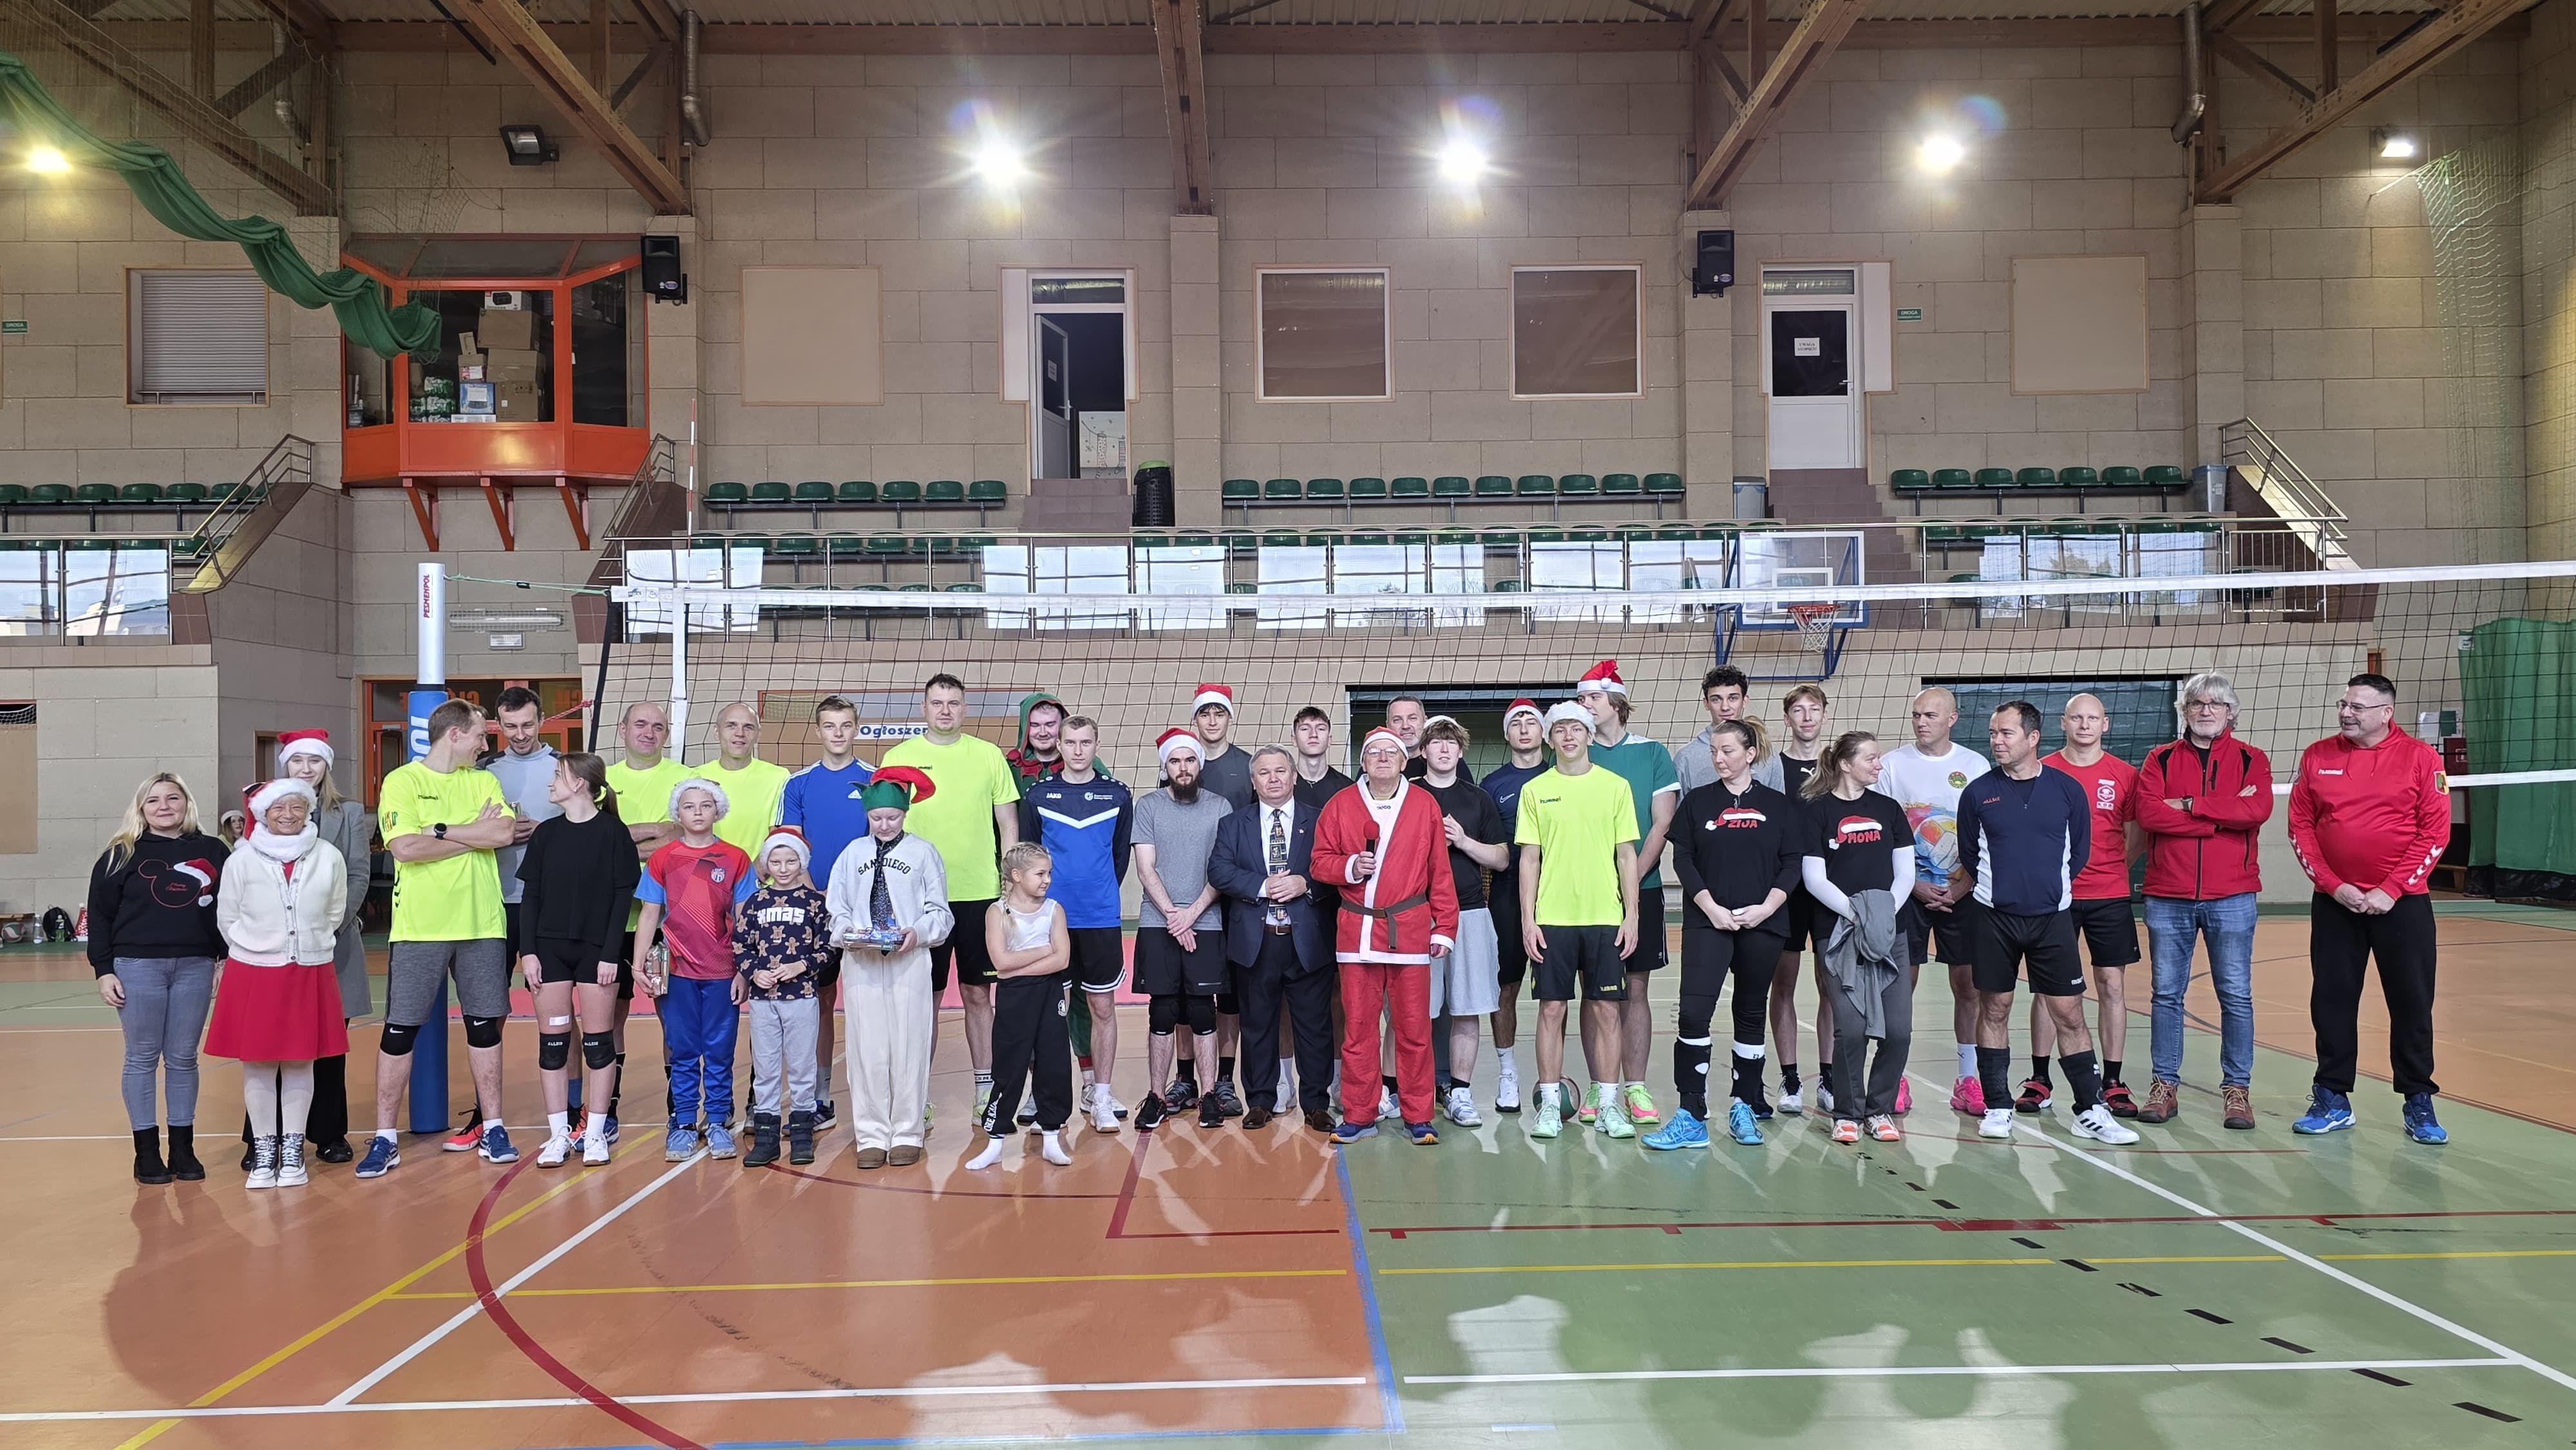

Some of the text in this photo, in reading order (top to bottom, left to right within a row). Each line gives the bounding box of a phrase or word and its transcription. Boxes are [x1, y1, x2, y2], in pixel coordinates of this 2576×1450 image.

[1727, 819, 1758, 828] ZIJA
[1847, 830, 1881, 844] MONA
[858, 858, 911, 876] SAN DIEGO
